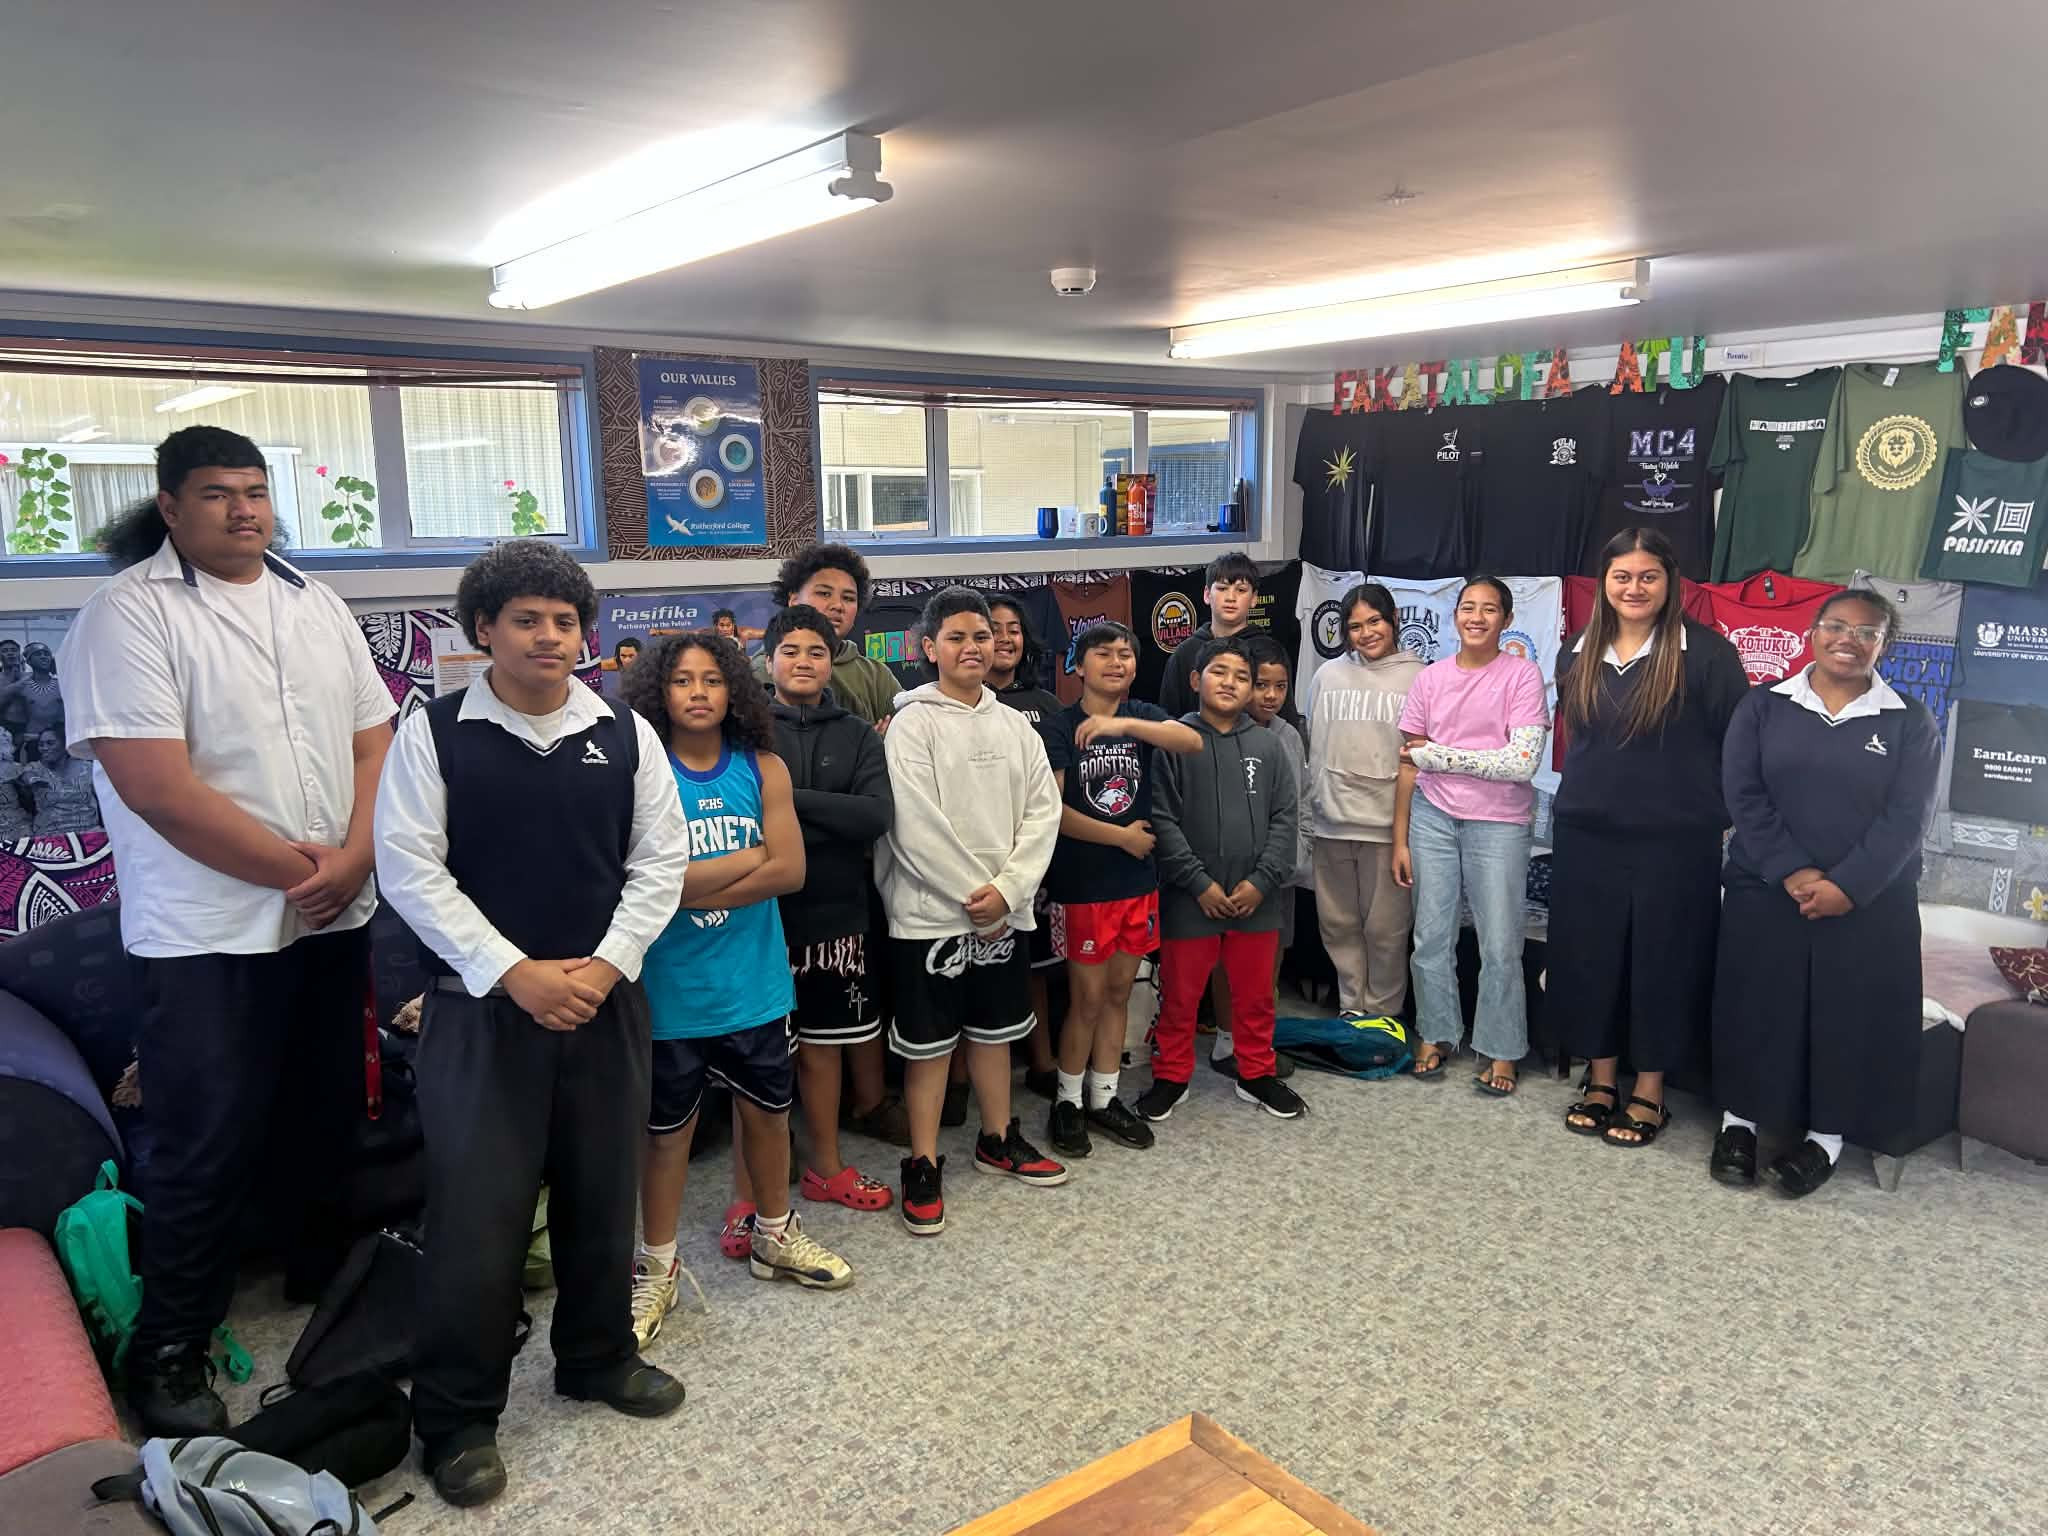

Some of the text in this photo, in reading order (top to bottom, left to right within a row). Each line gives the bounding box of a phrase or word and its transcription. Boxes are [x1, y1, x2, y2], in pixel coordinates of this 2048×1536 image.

[1609, 335, 1706, 395] ATU
[660, 372, 737, 386] OUR VALUES
[1628, 428, 1696, 456] MC4
[1436, 451, 1461, 461] PILOT
[1943, 535, 2025, 557] PASIFIKA
[611, 605, 698, 622] Pasifika
[618, 623, 650, 631] Pathways
[671, 619, 692, 628] Future
[1737, 636, 1791, 652] KOTUKU
[1973, 747, 2047, 765] EarnLearn
[1080, 755, 1141, 785] ROOSTERS
[2003, 765, 2024, 774] EARN
[2024, 767, 2033, 775] IT
